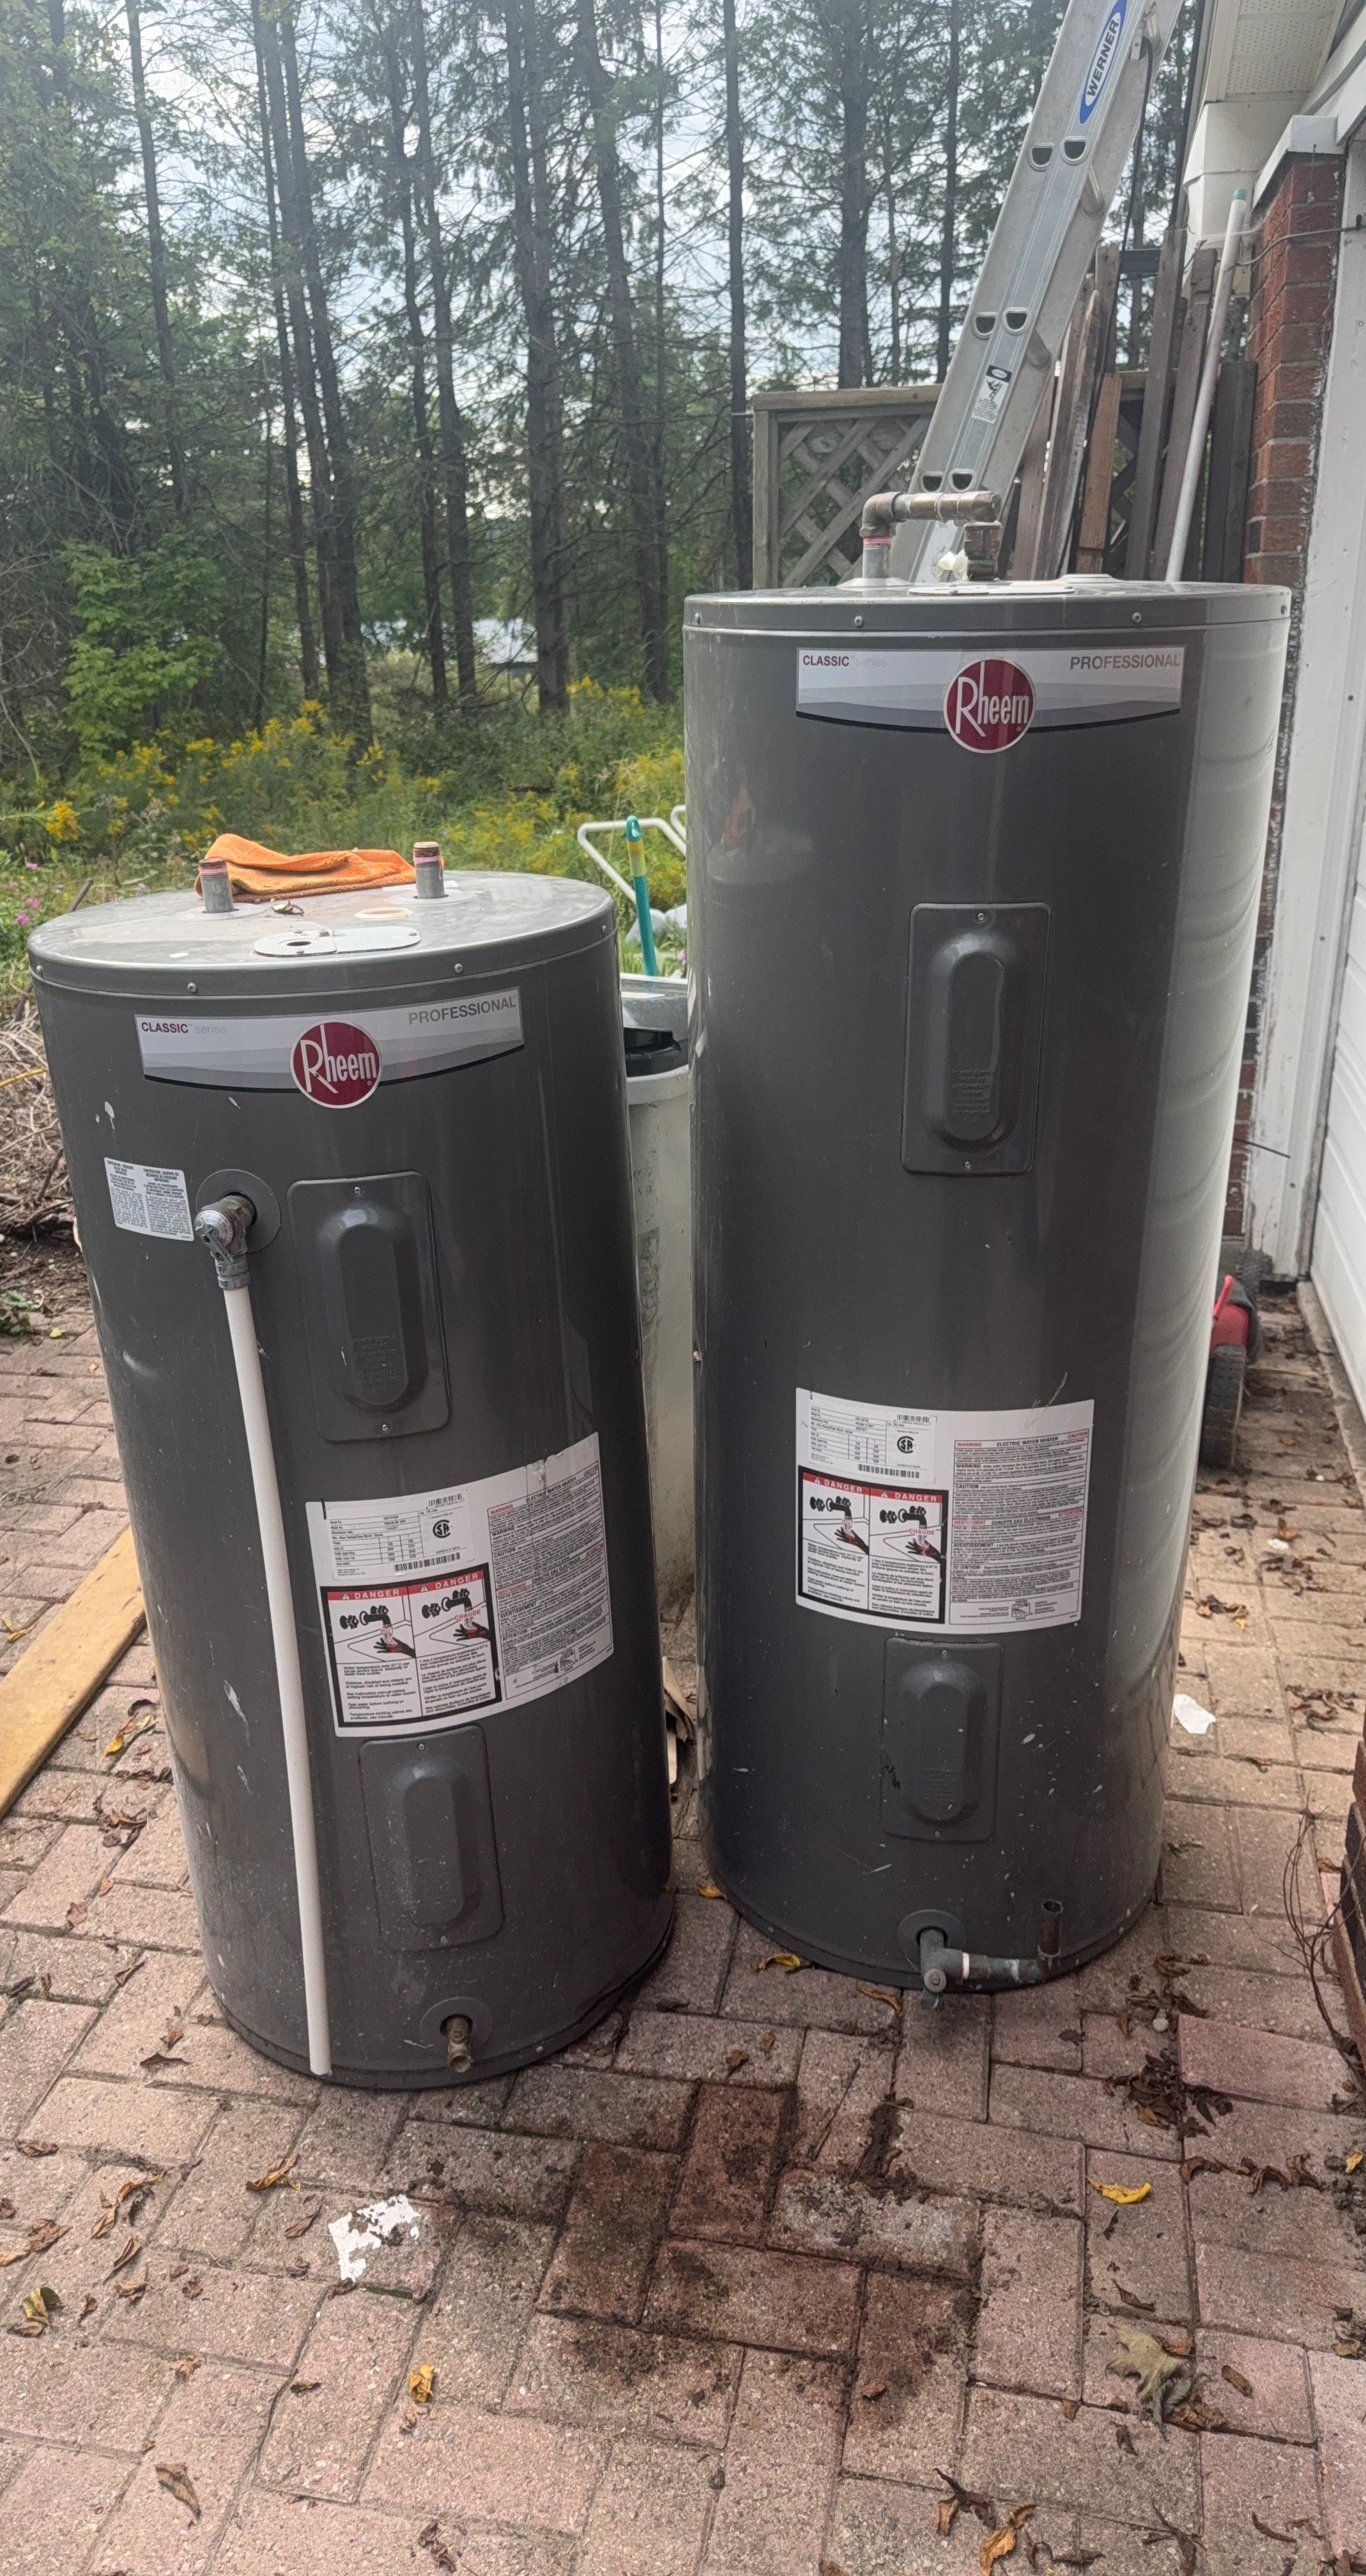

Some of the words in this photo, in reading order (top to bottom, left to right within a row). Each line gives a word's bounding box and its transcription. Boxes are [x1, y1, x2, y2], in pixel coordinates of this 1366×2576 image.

[1087, 19, 1119, 96] WERNER
[802, 655, 850, 666] CLASSIC
[856, 657, 887, 667] eries
[1070, 653, 1180, 670] PROFESSIONAL
[956, 661, 1029, 737] Rheem
[408, 997, 516, 1025] PROFESSIONAL
[141, 1022, 188, 1034] CLASSIC
[194, 1025, 227, 1034] series
[300, 1024, 378, 1093] Rheem
[824, 1480, 863, 1493] DANGER
[894, 1492, 937, 1502] DANGER
[494, 1547, 516, 1558] CAUTION
[435, 1573, 479, 1589] DANGER
[354, 1589, 399, 1599] DANGER
[454, 1609, 481, 1620] CHAUDE
